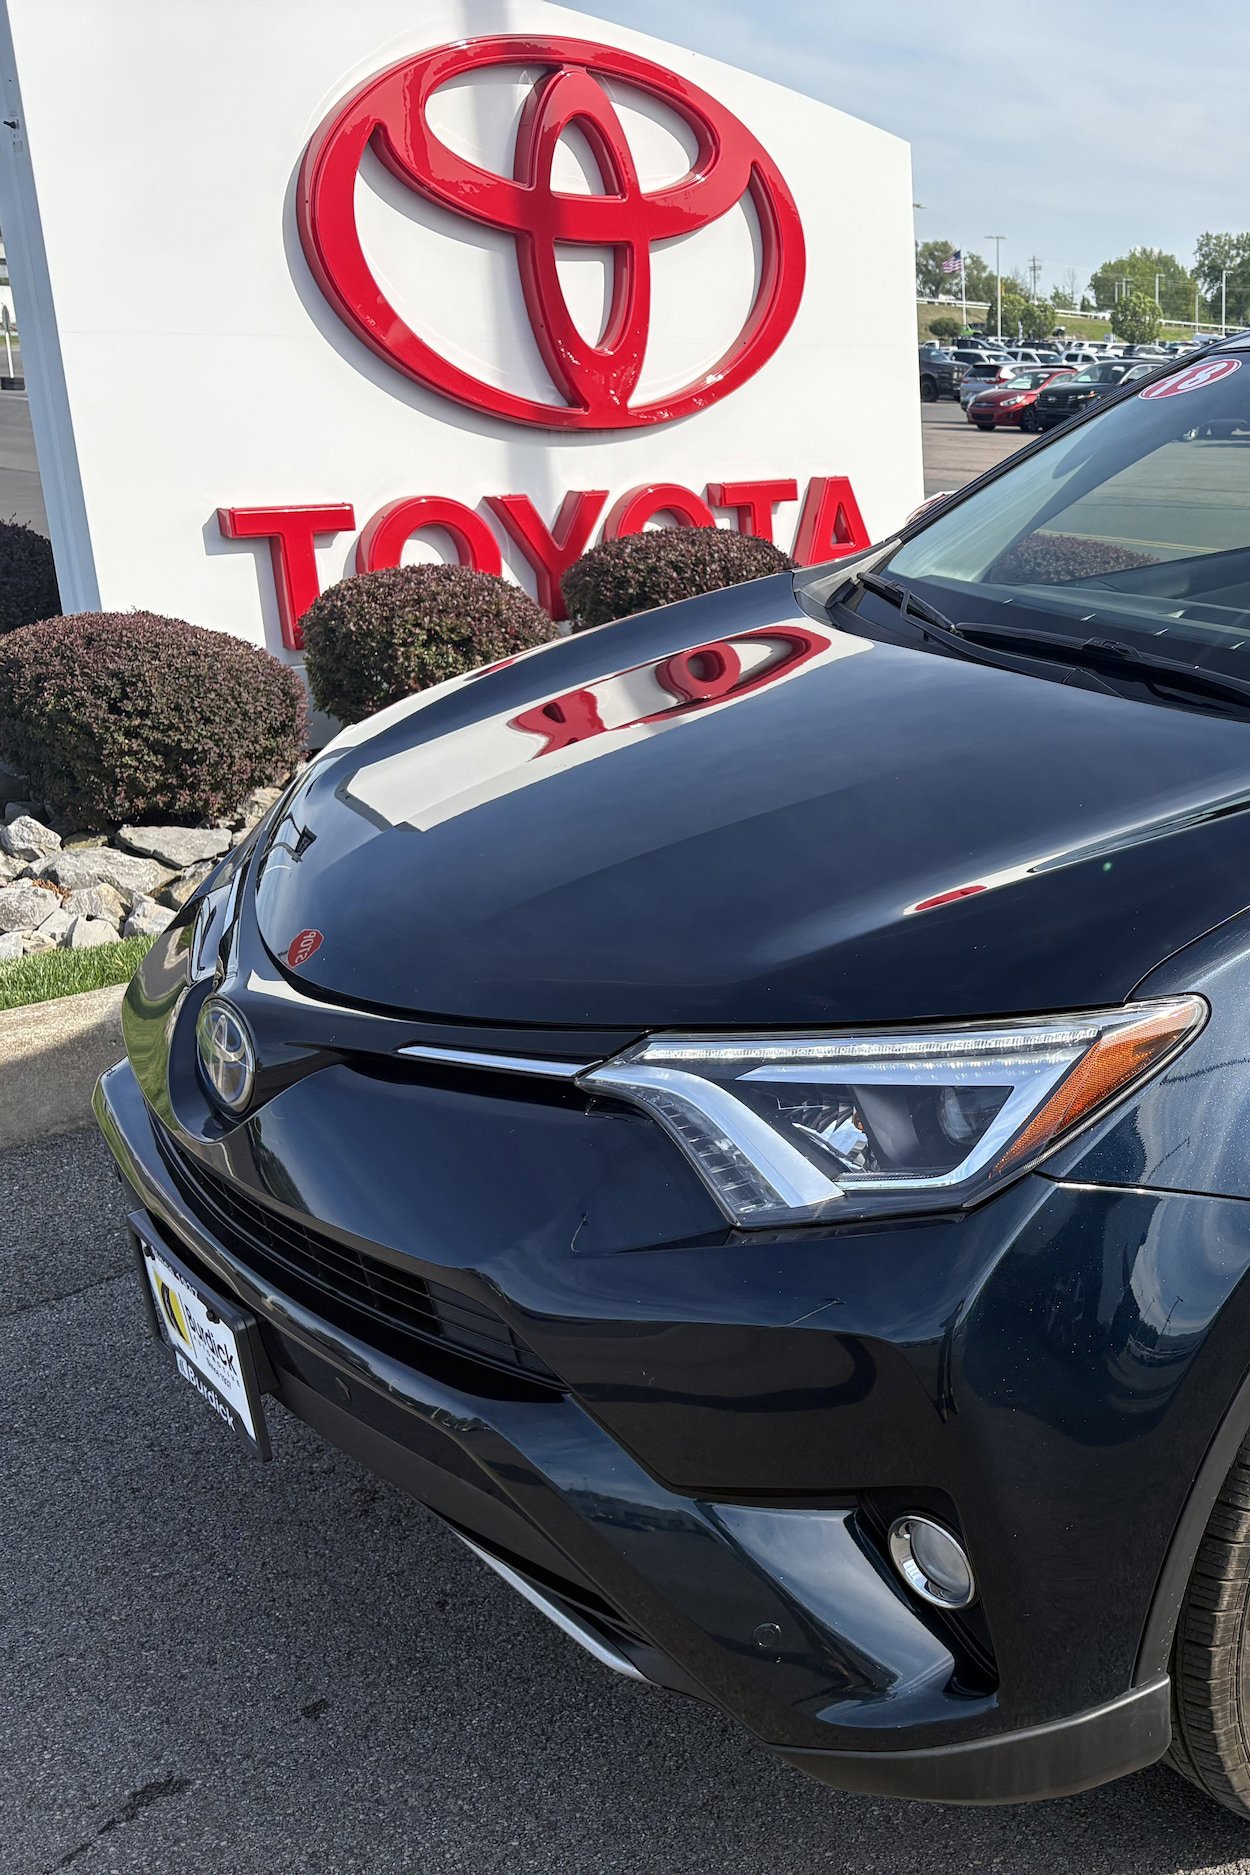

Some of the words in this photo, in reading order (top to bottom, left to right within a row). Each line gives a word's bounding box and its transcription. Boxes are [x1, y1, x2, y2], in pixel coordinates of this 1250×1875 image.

[1149, 361, 1229, 398] 18
[184, 1303, 238, 1377] Burdick
[187, 1367, 237, 1432] Burdick
